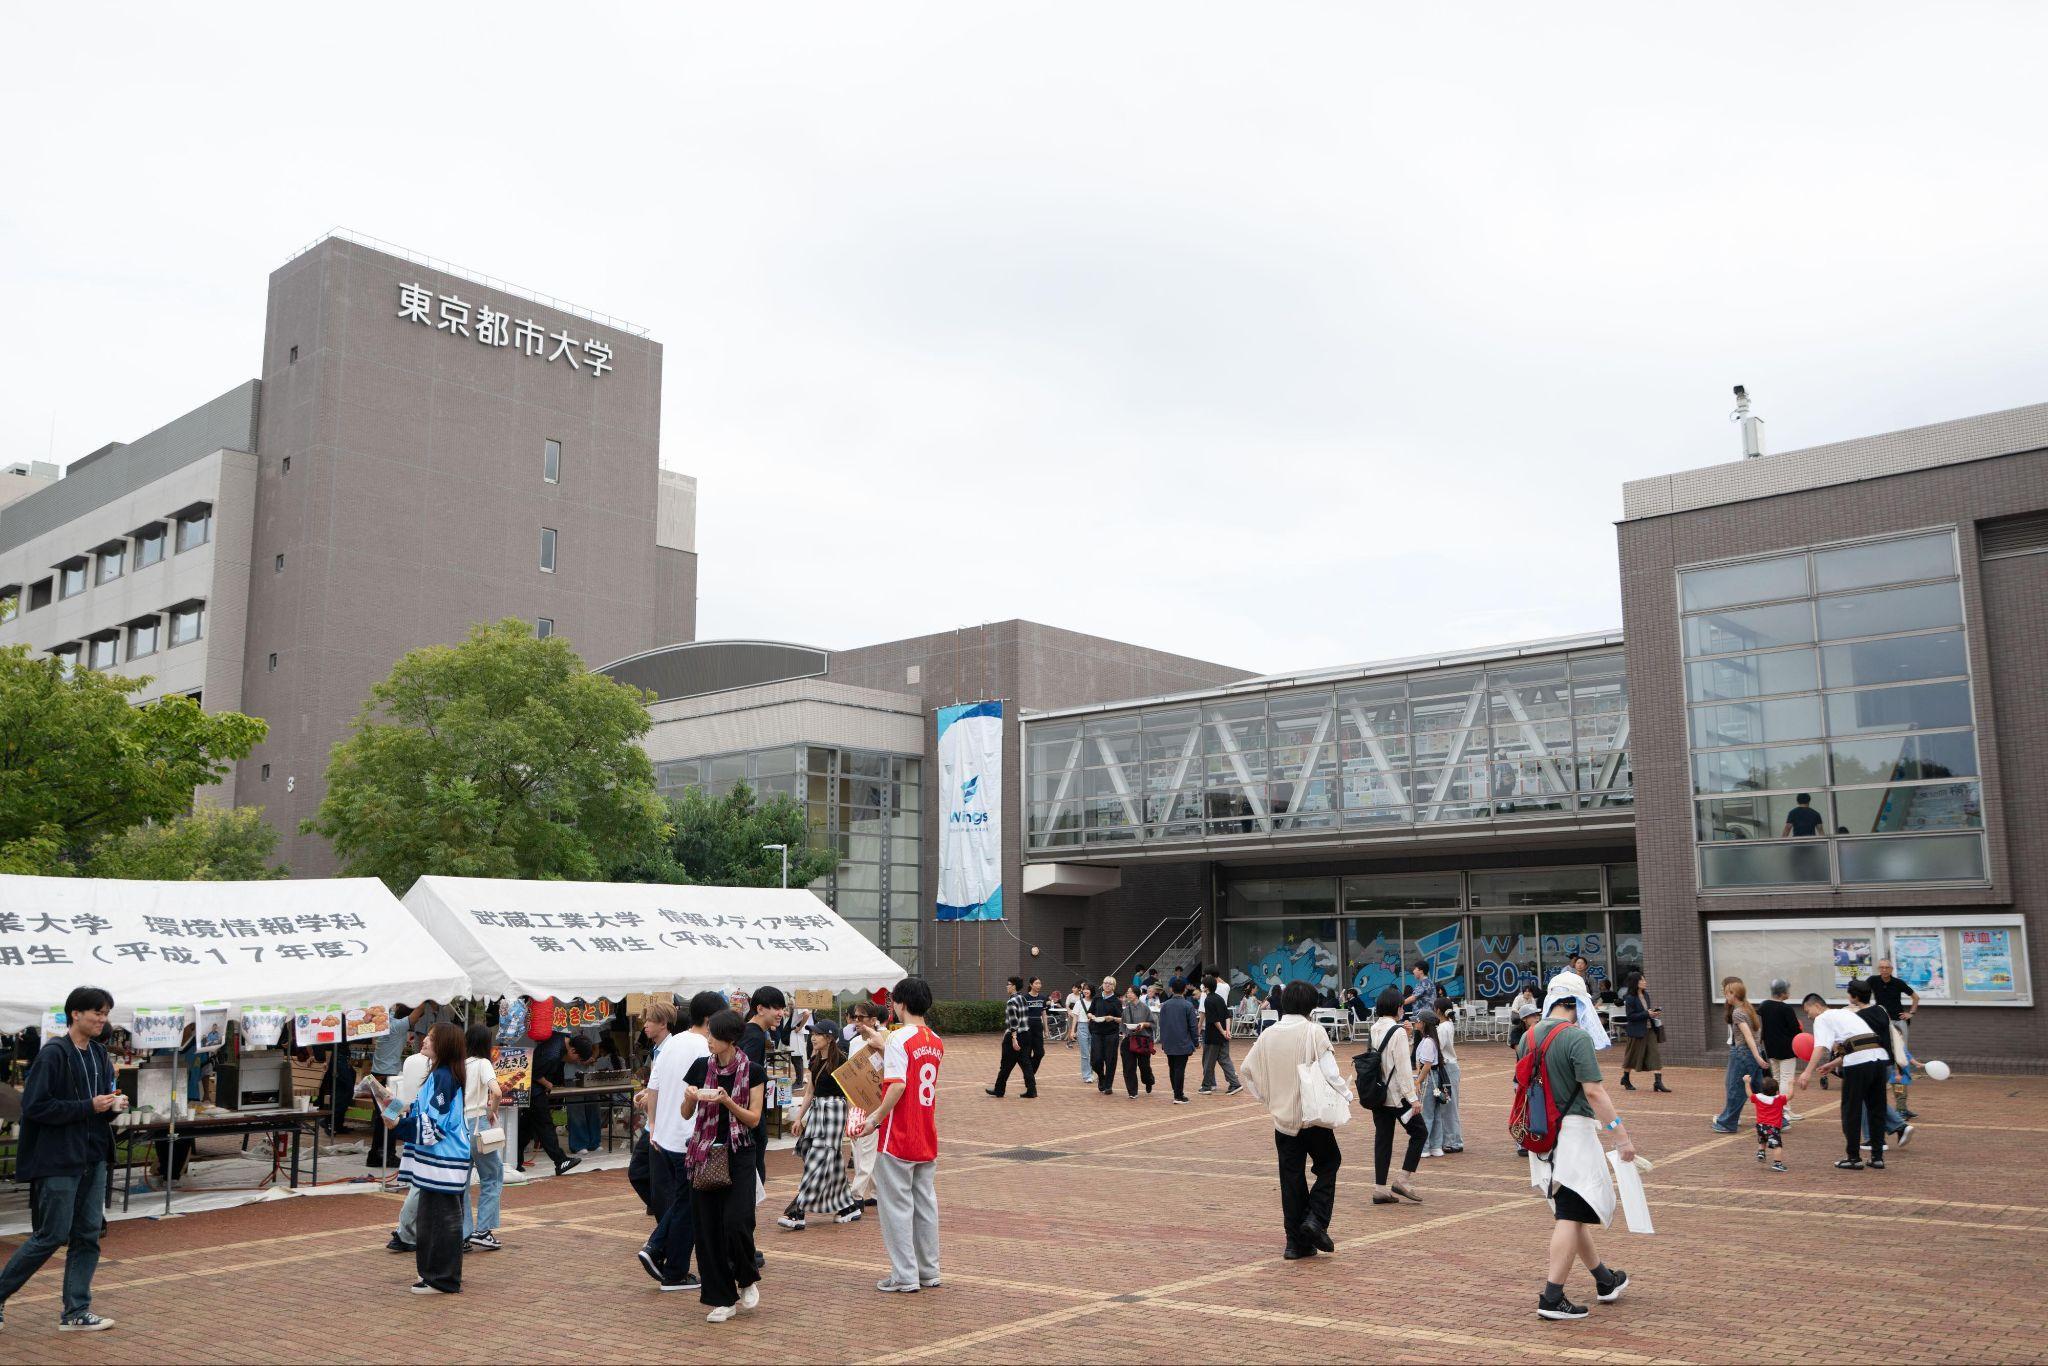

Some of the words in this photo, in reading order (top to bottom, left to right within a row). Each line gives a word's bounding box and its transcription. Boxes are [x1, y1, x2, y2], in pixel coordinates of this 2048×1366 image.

[398, 282, 613, 376] 東京都市大学
[949, 810, 988, 825] Wings
[142, 912, 367, 939] 環境情報学科
[470, 908, 645, 929] 武蔵工業大学
[657, 907, 836, 931] 情報メディア学科
[552, 1000, 610, 1028] 焼きとり
[495, 1054, 529, 1069] 焼き鳥
[918, 1062, 937, 1107] 8
